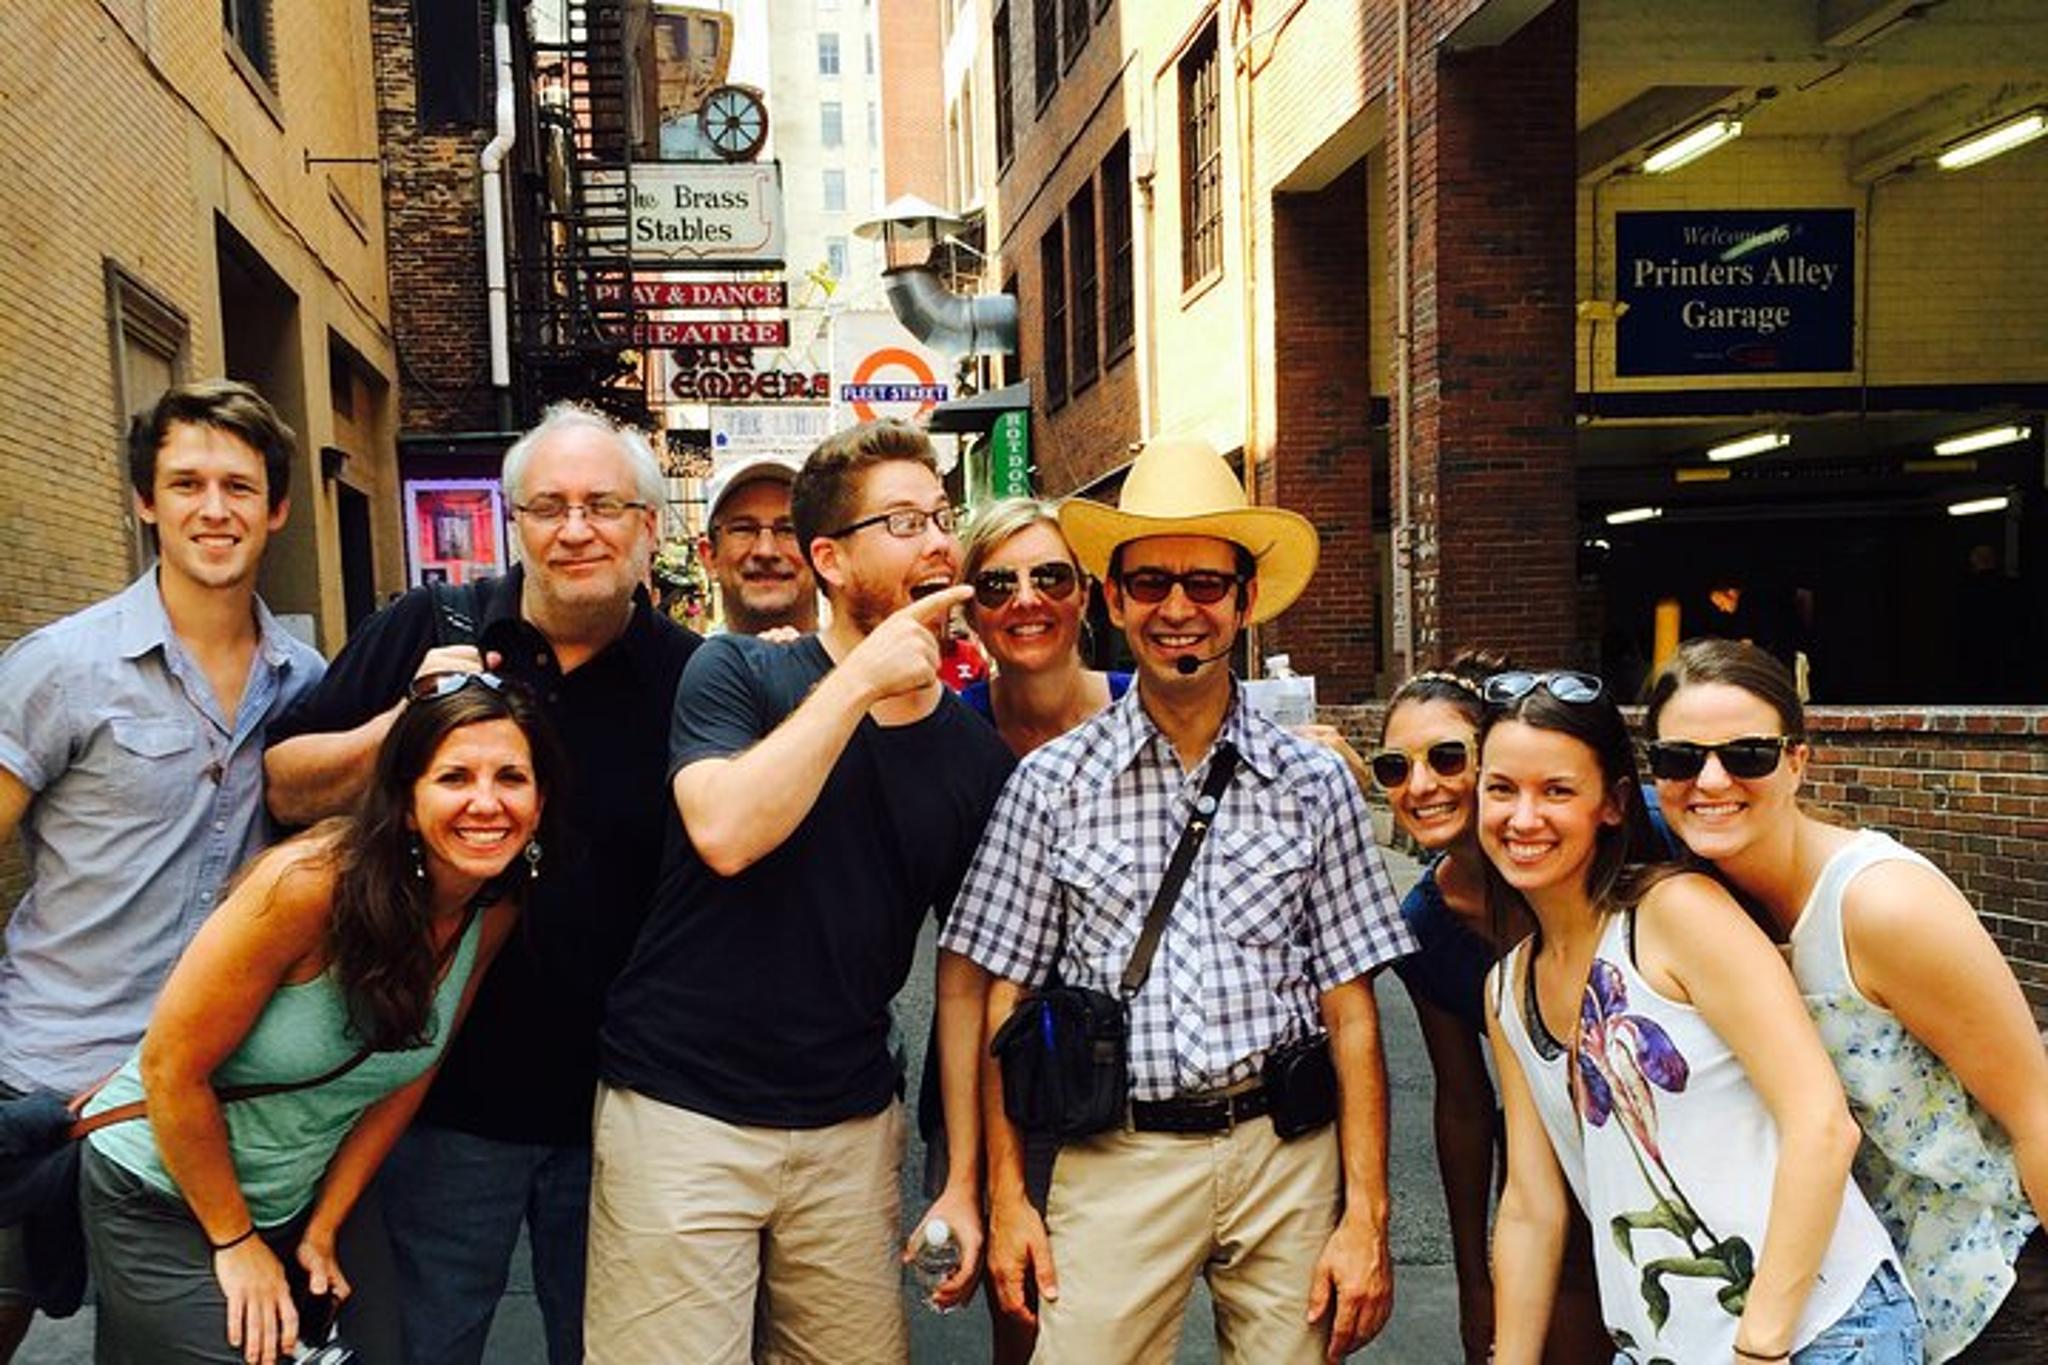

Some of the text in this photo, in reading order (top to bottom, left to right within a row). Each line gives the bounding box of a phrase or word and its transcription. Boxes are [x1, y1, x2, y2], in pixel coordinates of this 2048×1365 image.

[616, 183, 750, 210] he Brass
[636, 216, 733, 242] Stables
[1634, 256, 1839, 291] Printers Alley
[667, 283, 687, 303] &
[693, 283, 783, 303] DANCE
[1681, 299, 1791, 335] Garage
[608, 322, 778, 344] HEATRE
[844, 385, 946, 401] FLEET STREET
